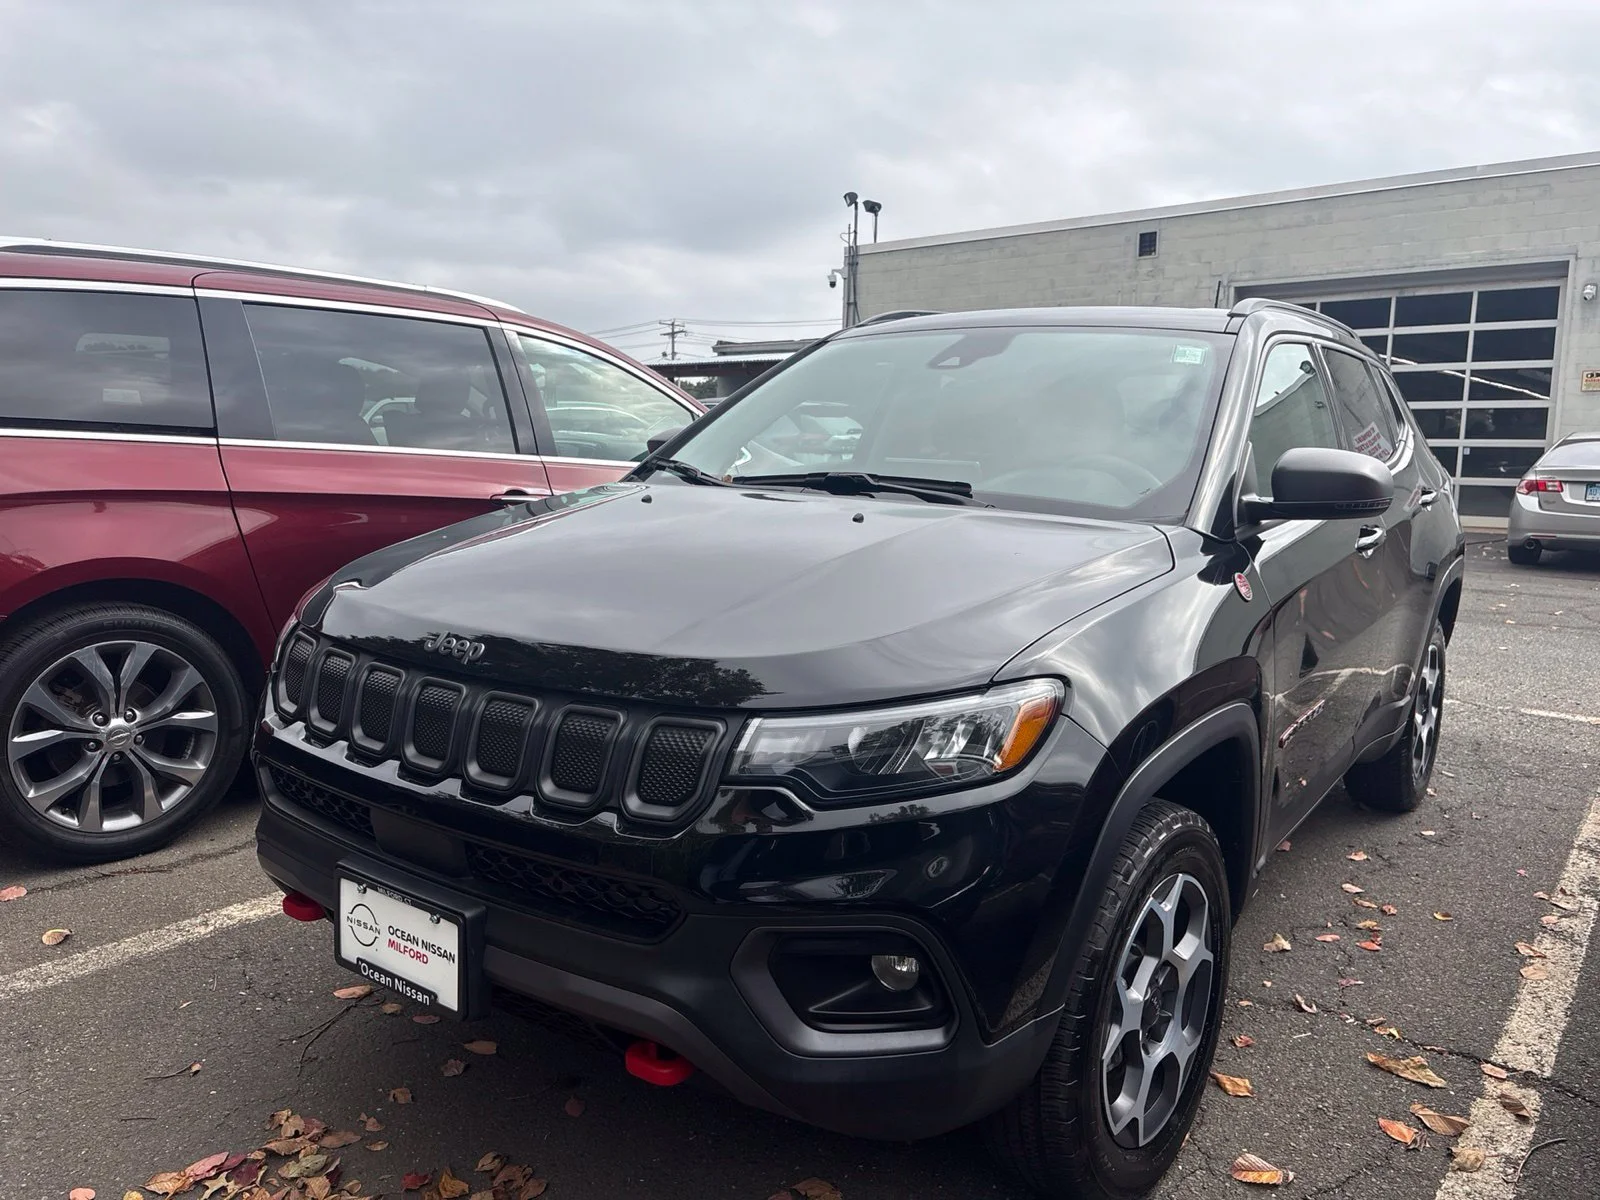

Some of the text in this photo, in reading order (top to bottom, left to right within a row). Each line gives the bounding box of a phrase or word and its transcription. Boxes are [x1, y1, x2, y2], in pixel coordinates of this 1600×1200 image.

[424, 631, 485, 665] Jeep
[346, 915, 381, 935] NISSAN
[387, 925, 455, 964] OCEAN NISSAN
[387, 938, 429, 964] MILFORD
[360, 963, 430, 1005] Ocean Nissan
